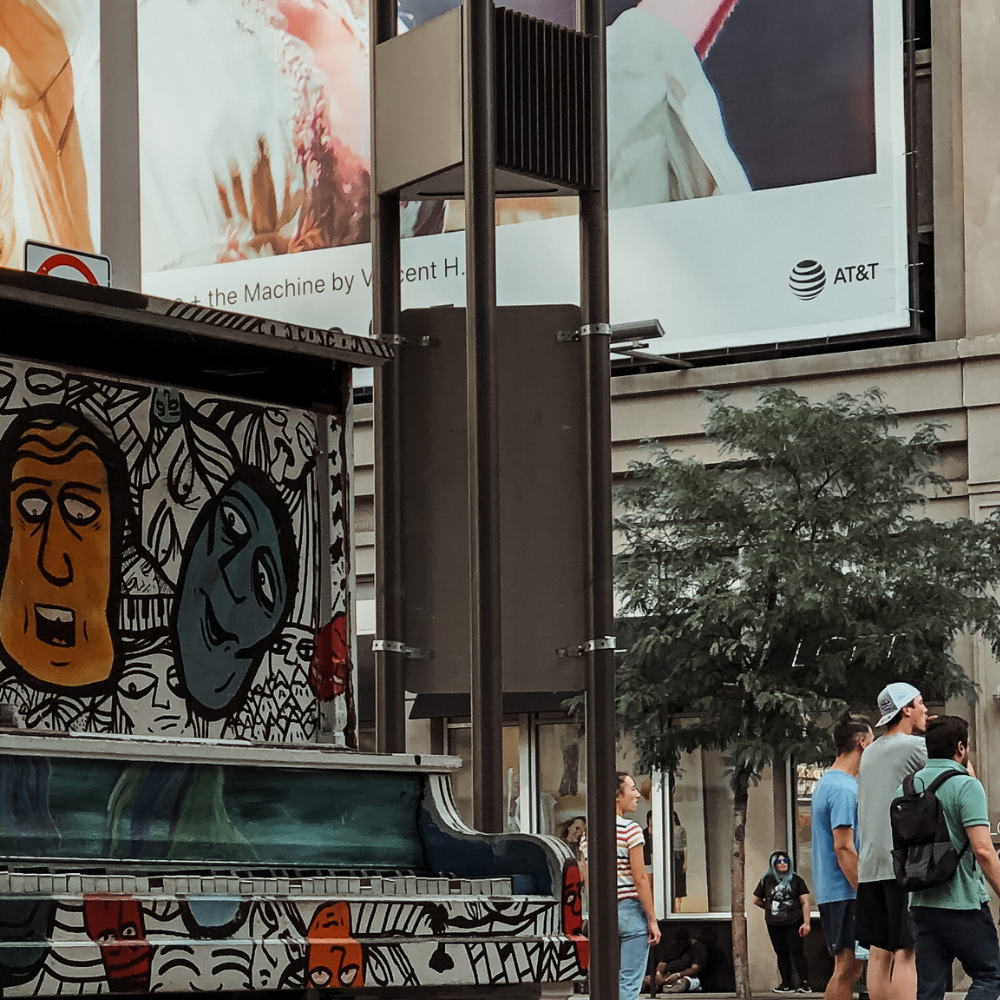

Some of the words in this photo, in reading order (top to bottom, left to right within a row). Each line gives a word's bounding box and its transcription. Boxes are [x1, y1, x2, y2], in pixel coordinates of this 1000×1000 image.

[207, 288, 237, 307] the
[245, 277, 325, 303] Machine
[332, 272, 354, 294] by
[361, 261, 436, 287] Vent
[444, 256, 465, 278] H.
[833, 262, 879, 285] AT&T
